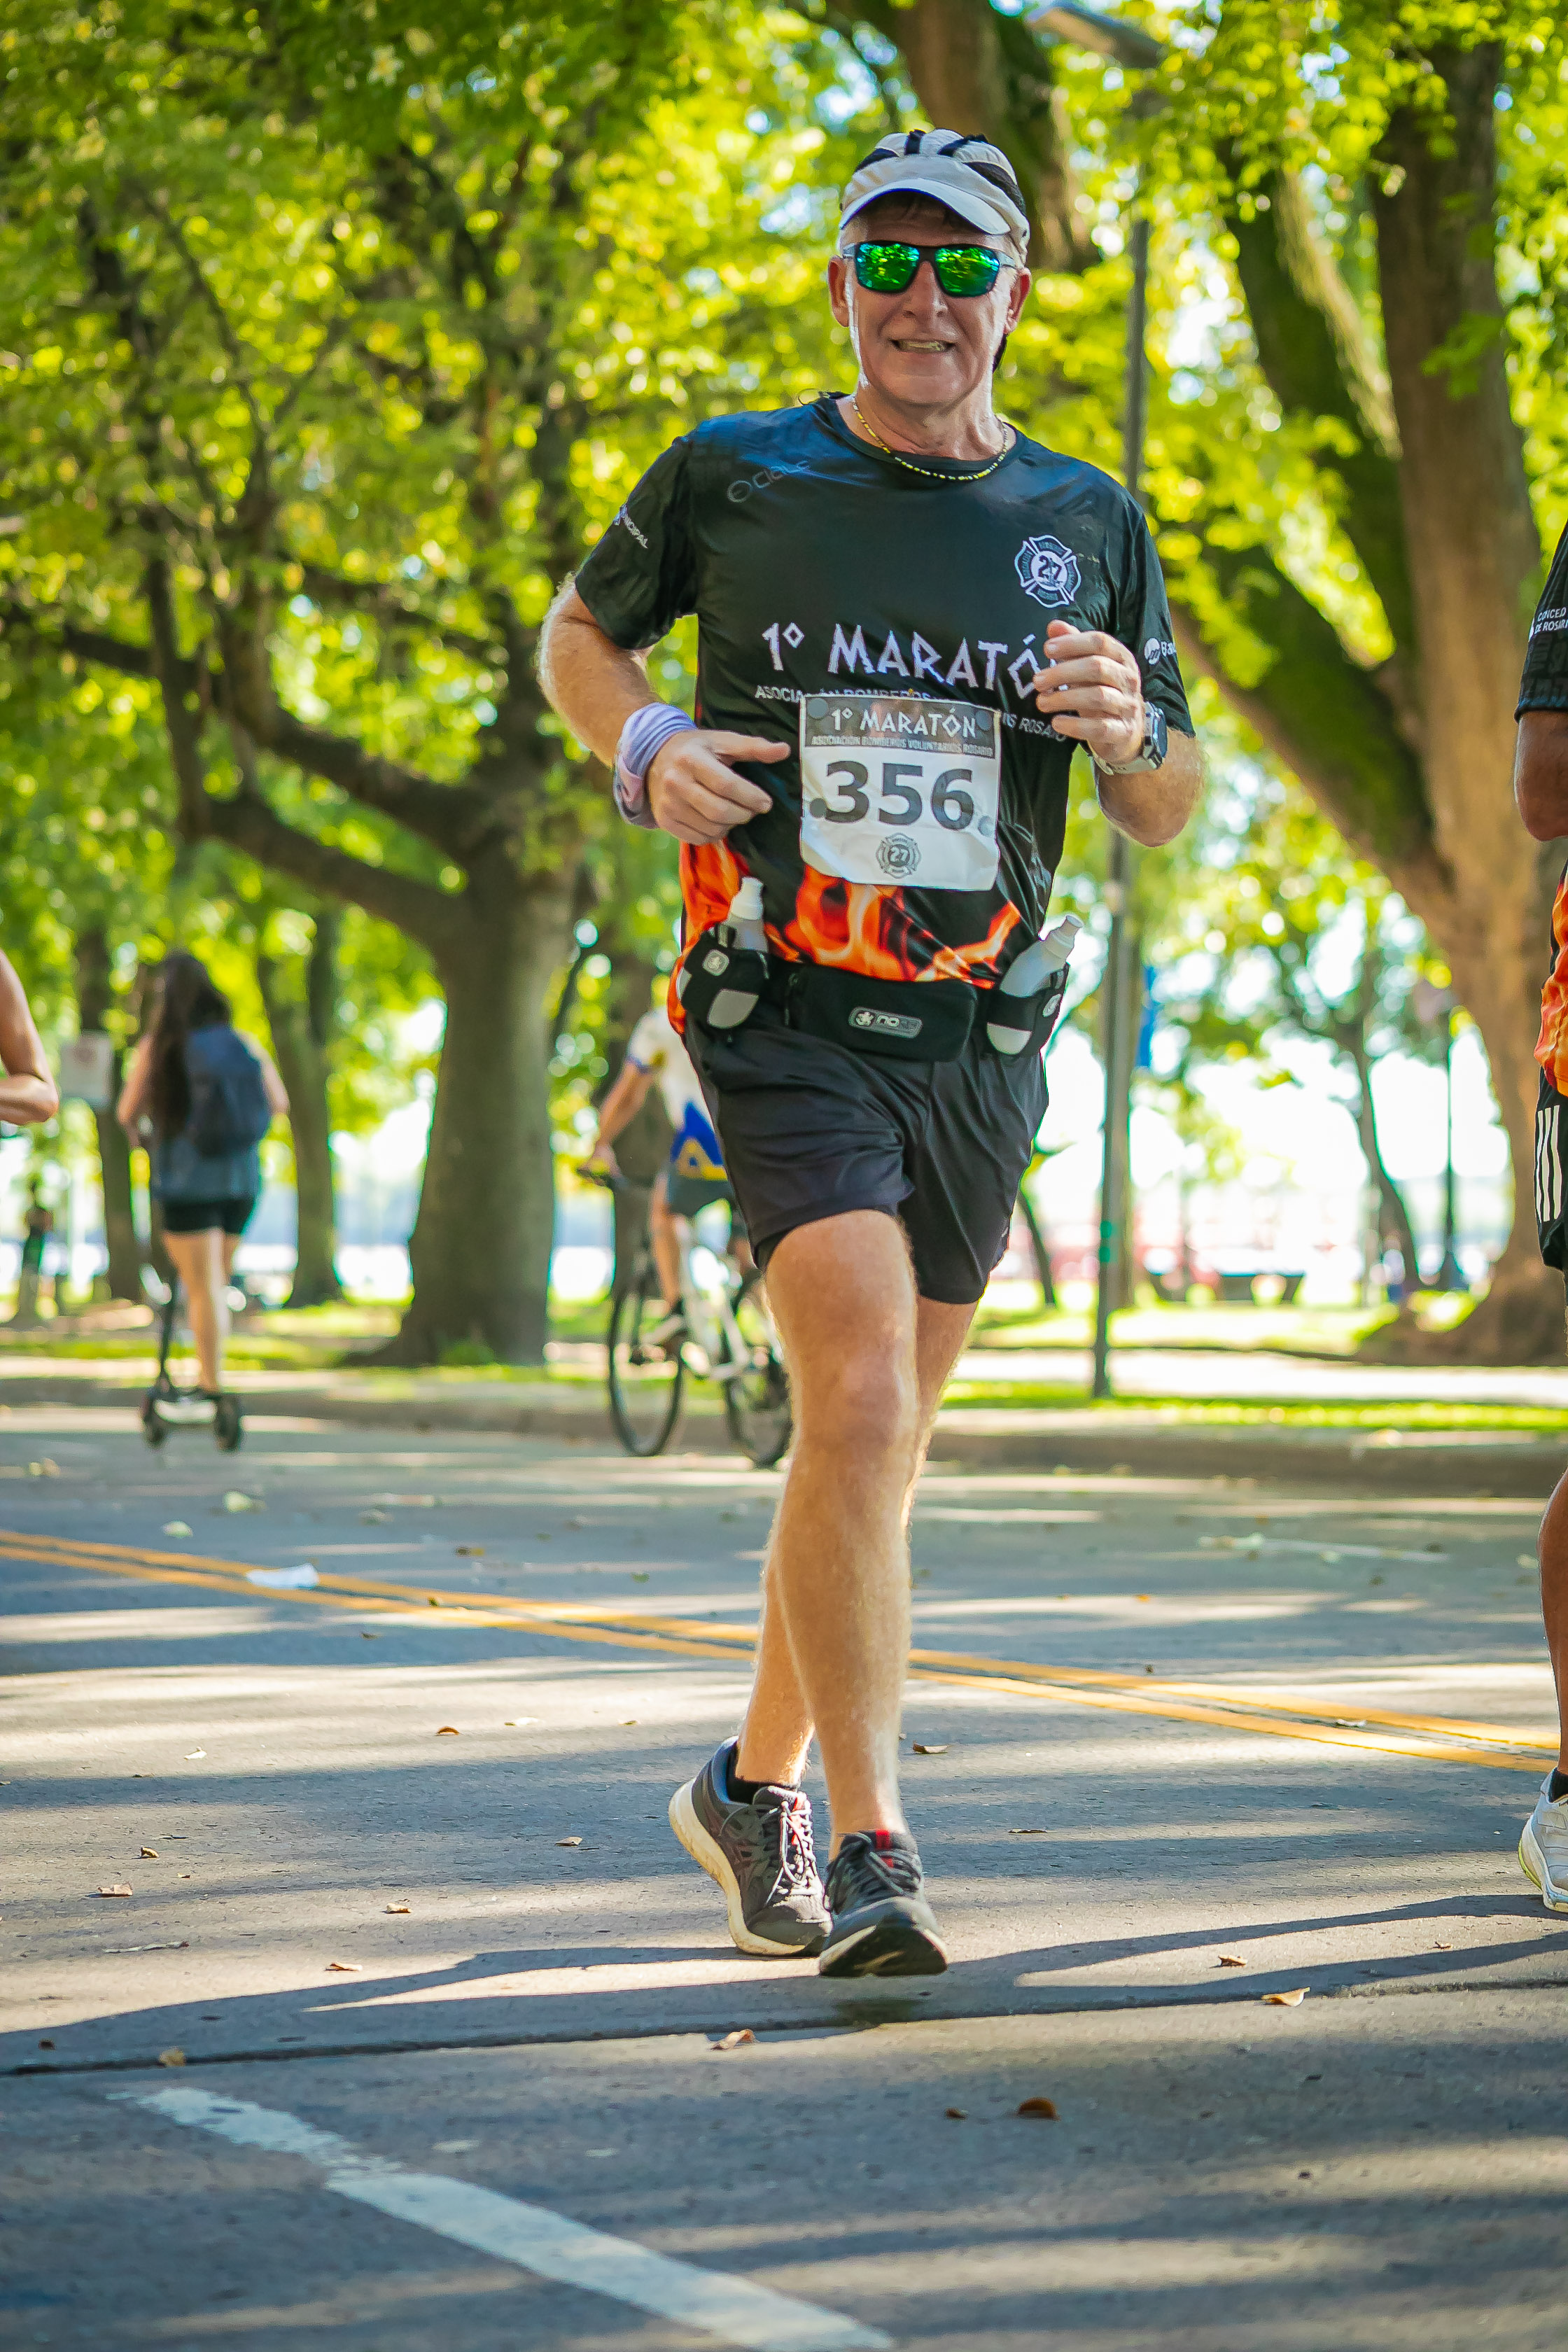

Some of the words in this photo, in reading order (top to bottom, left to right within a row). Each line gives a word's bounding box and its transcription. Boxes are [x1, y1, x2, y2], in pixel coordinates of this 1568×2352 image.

[1542, 619, 1568, 631] ROSARI
[827, 622, 1068, 699] MARATÓ
[860, 705, 976, 738] MARATÓN
[825, 760, 974, 832] 356
[890, 846, 909, 862] 27
